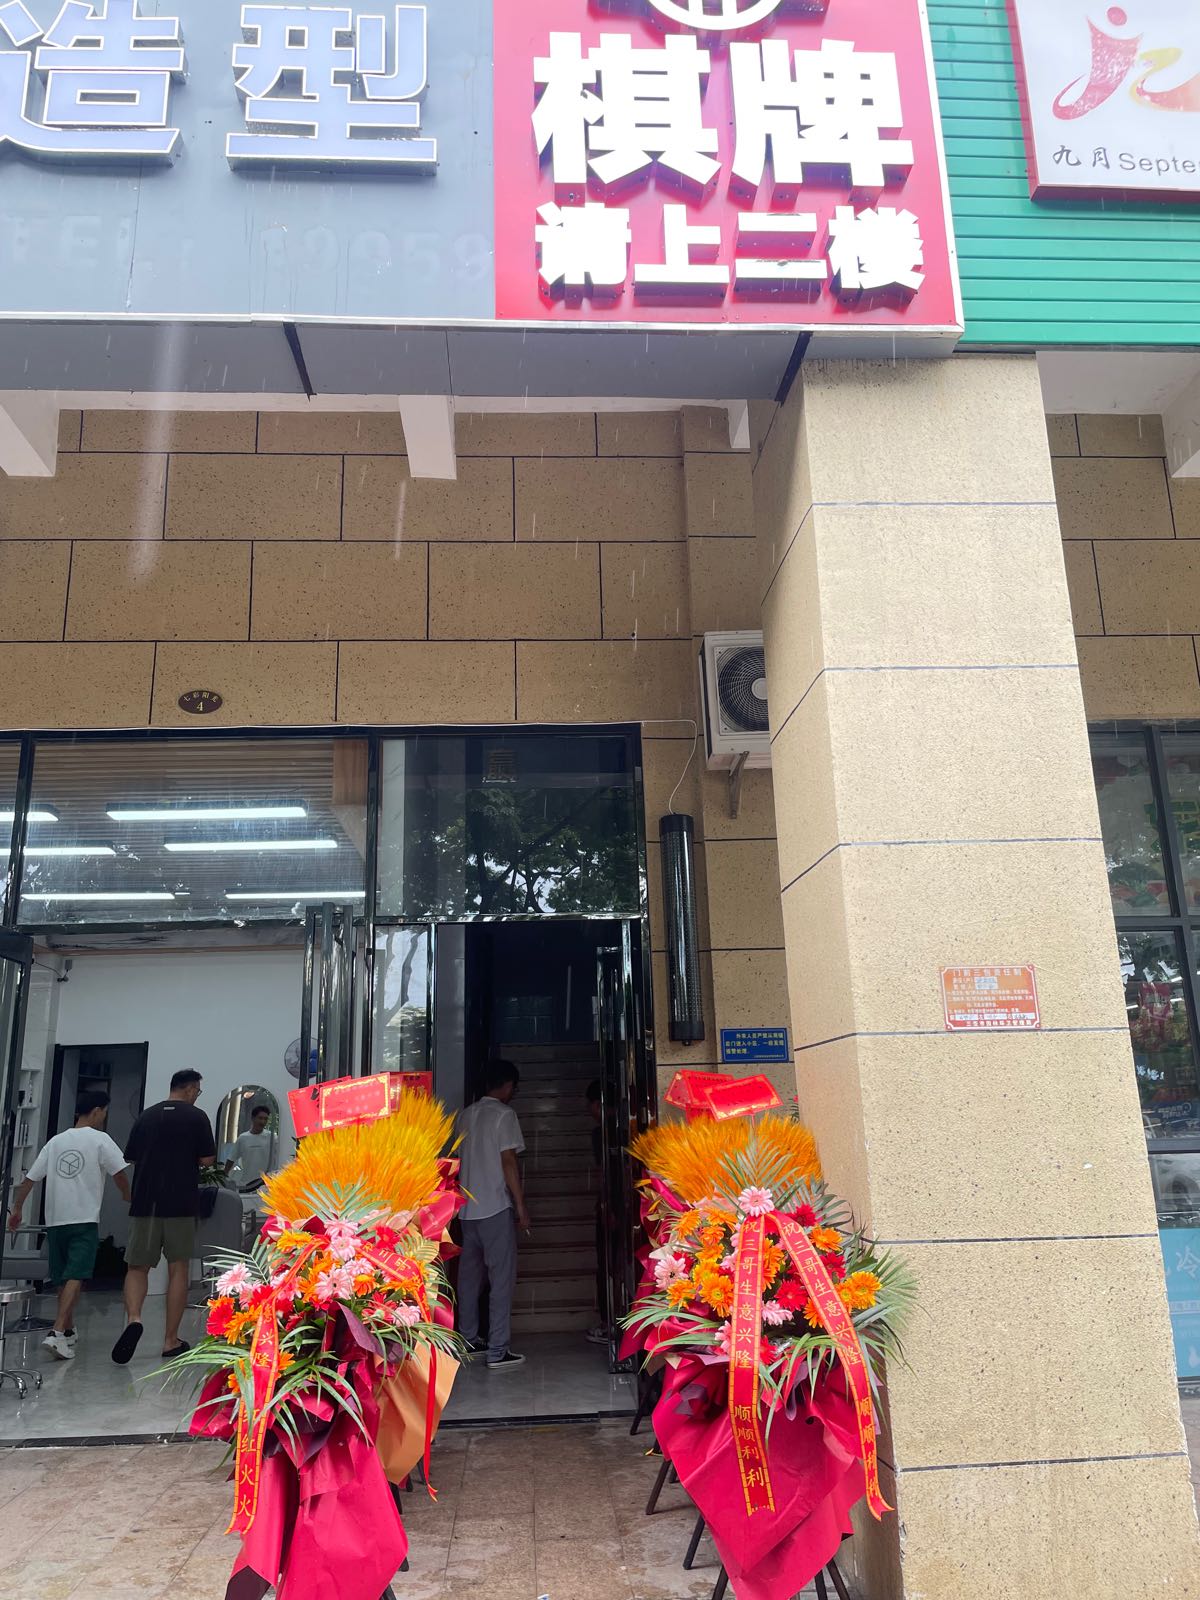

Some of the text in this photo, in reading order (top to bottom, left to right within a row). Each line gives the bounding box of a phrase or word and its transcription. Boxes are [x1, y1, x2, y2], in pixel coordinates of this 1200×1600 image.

[0, 0, 438, 166] 造型
[532, 31, 914, 189] 棋牌
[1052, 144, 1200, 177] 九月 Septe
[196, 701, 204, 711] 4
[735, 1220, 761, 1369] 祝三哥生意兴隆
[733, 1405, 766, 1489] 顺顺利利
